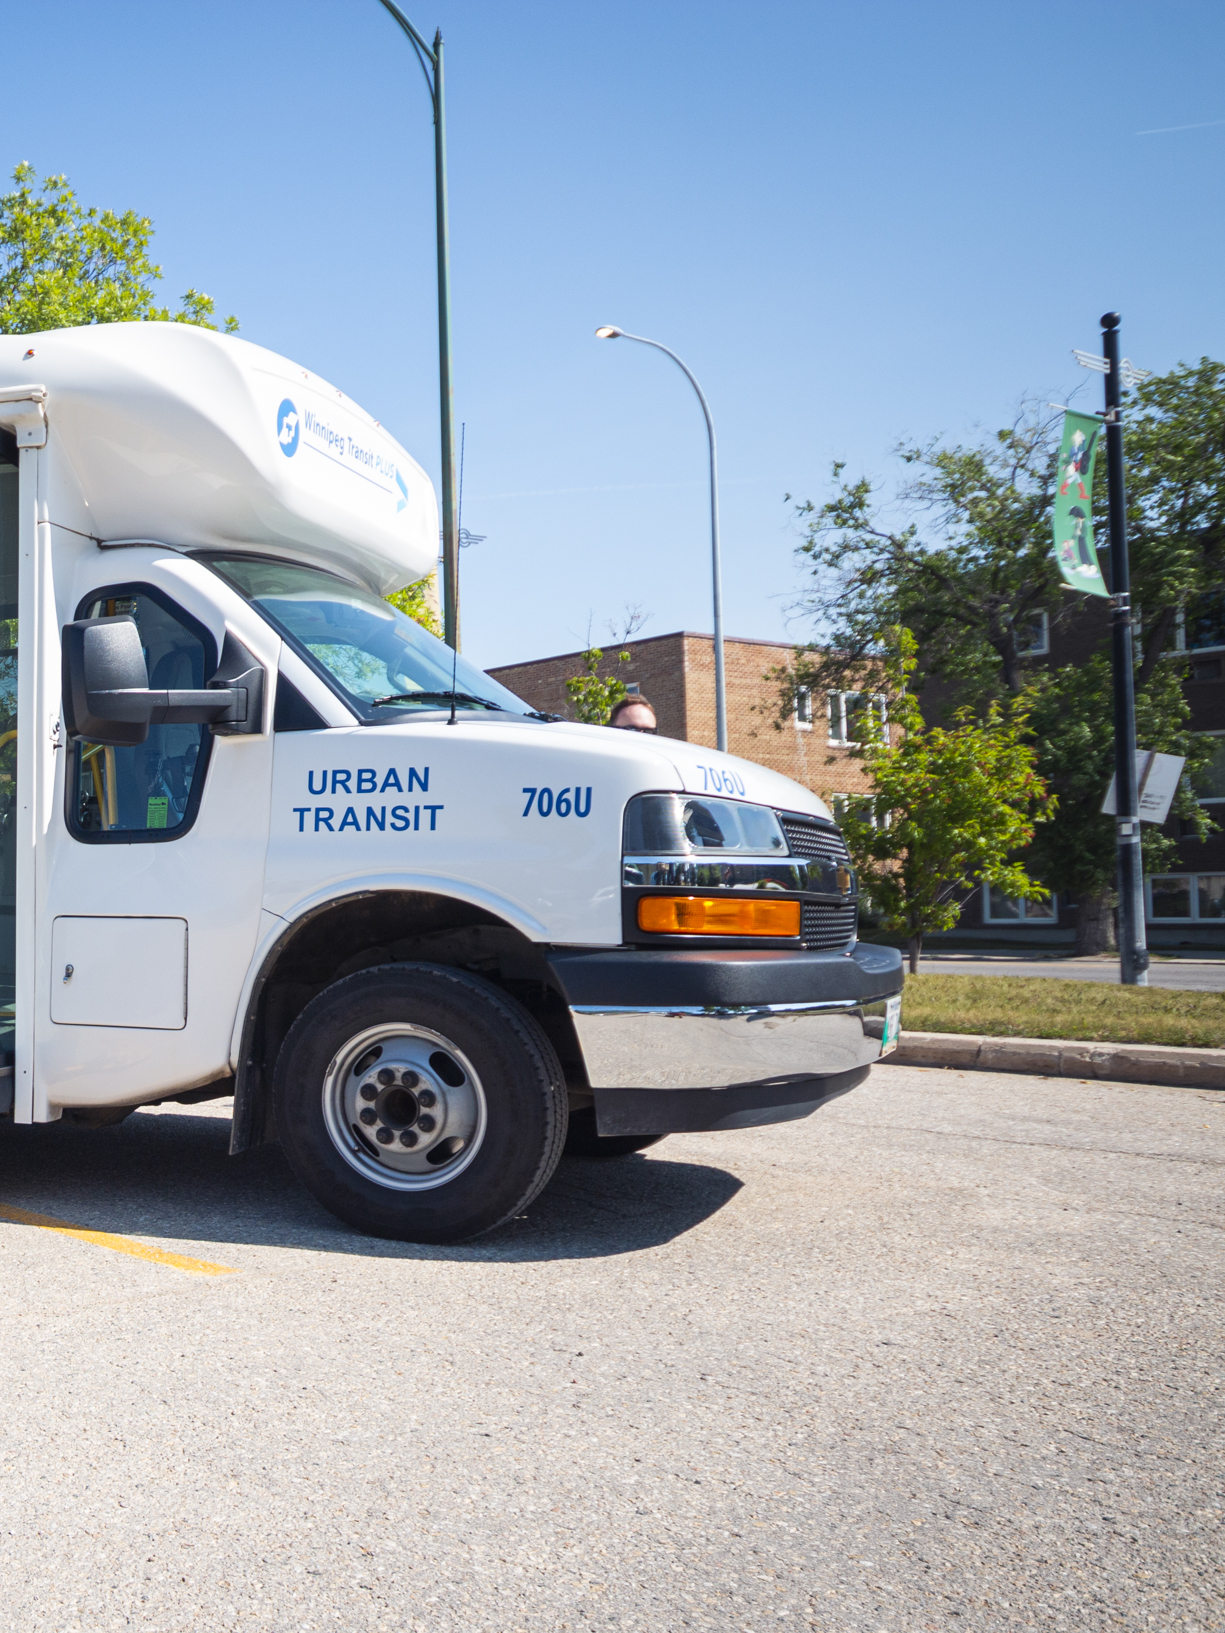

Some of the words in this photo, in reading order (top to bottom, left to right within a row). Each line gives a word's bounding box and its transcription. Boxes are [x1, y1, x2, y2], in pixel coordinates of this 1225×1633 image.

[304, 408, 345, 456] Winnipeg
[347, 436, 374, 468] Transit
[375, 455, 395, 479] PLUS
[308, 767, 430, 795] URBAN
[696, 765, 745, 796] 706U
[522, 786, 592, 818] 706U
[293, 805, 444, 832] TRANSIT
